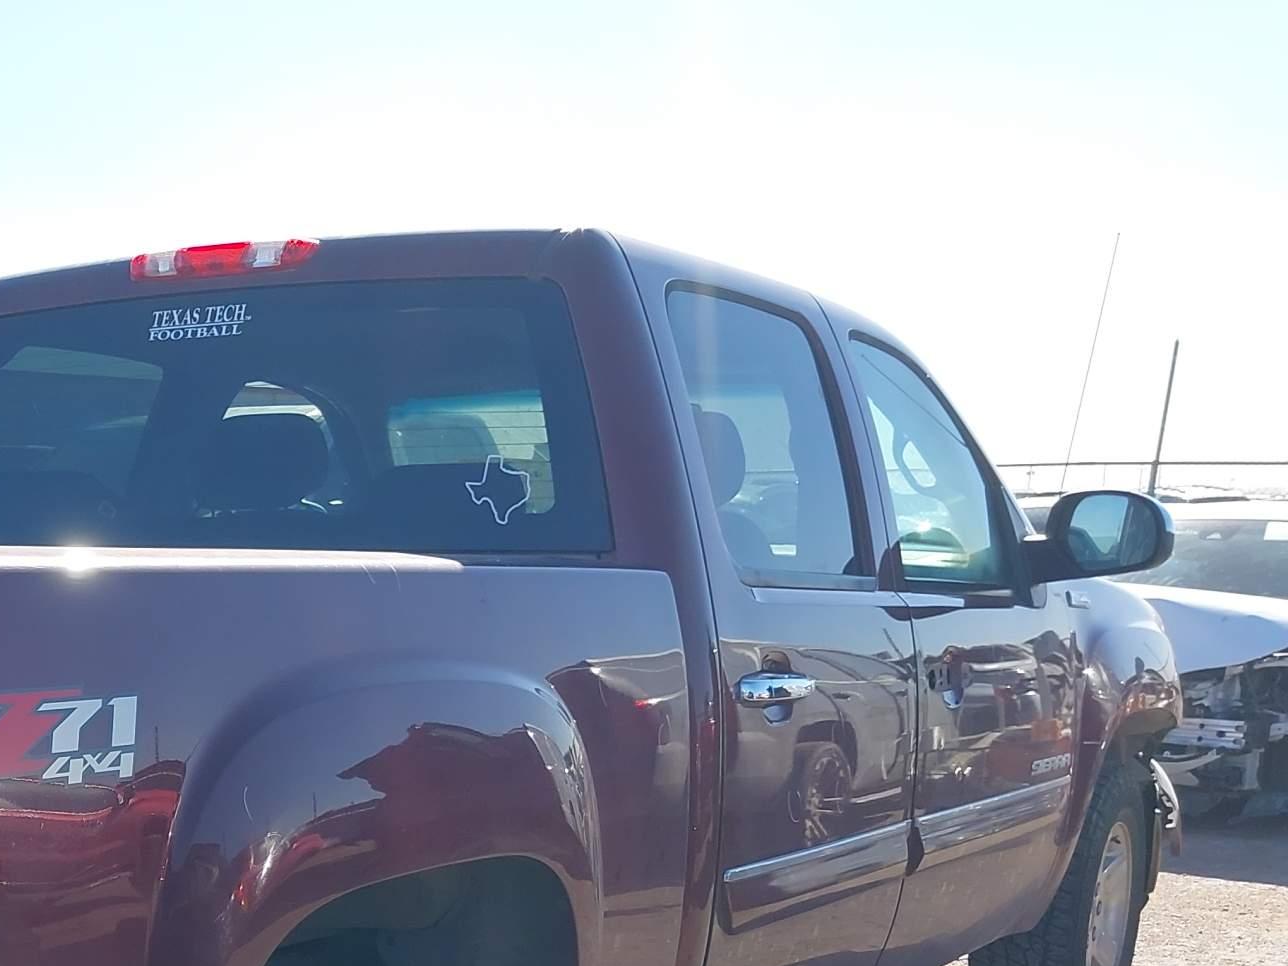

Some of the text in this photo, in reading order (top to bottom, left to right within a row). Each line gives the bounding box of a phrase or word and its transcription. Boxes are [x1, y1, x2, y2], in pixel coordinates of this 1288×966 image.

[152, 303, 247, 328] TEXAS TECH
[148, 324, 243, 341] FOOTBALL
[1031, 753, 1071, 775] SIERRA
